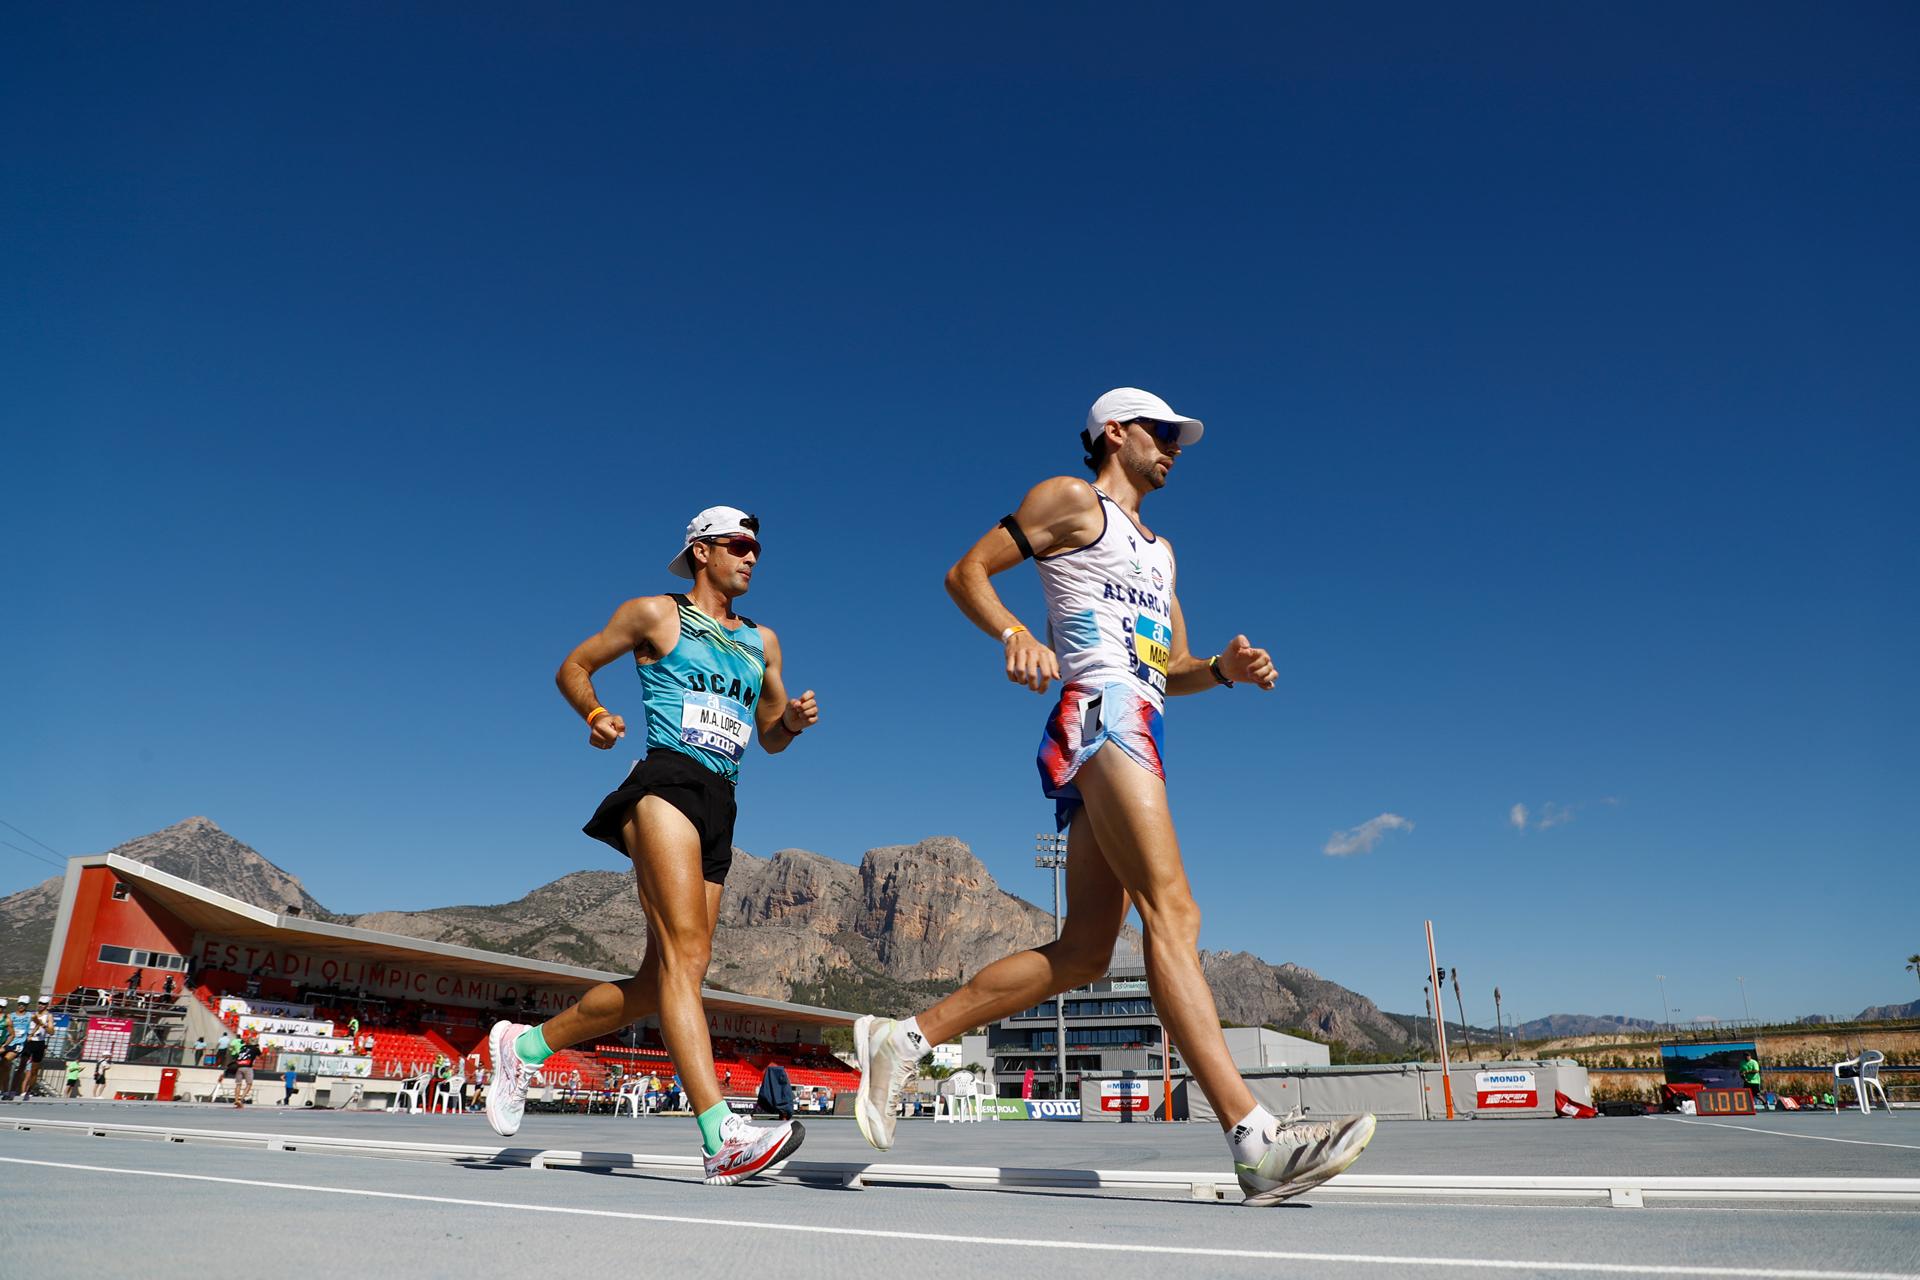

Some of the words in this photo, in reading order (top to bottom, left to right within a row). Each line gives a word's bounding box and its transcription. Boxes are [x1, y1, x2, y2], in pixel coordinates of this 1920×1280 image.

[1149, 645, 1170, 670] MAR
[700, 709, 719, 727] M.A.
[720, 715, 742, 738] LOPEZ
[202, 941, 312, 977] ESTADI
[384, 1062, 404, 1079] LA
[1490, 1075, 1526, 1083] MONDO
[1112, 1082, 1141, 1090] MONDO
[1708, 1092, 1748, 1112] 1.00
